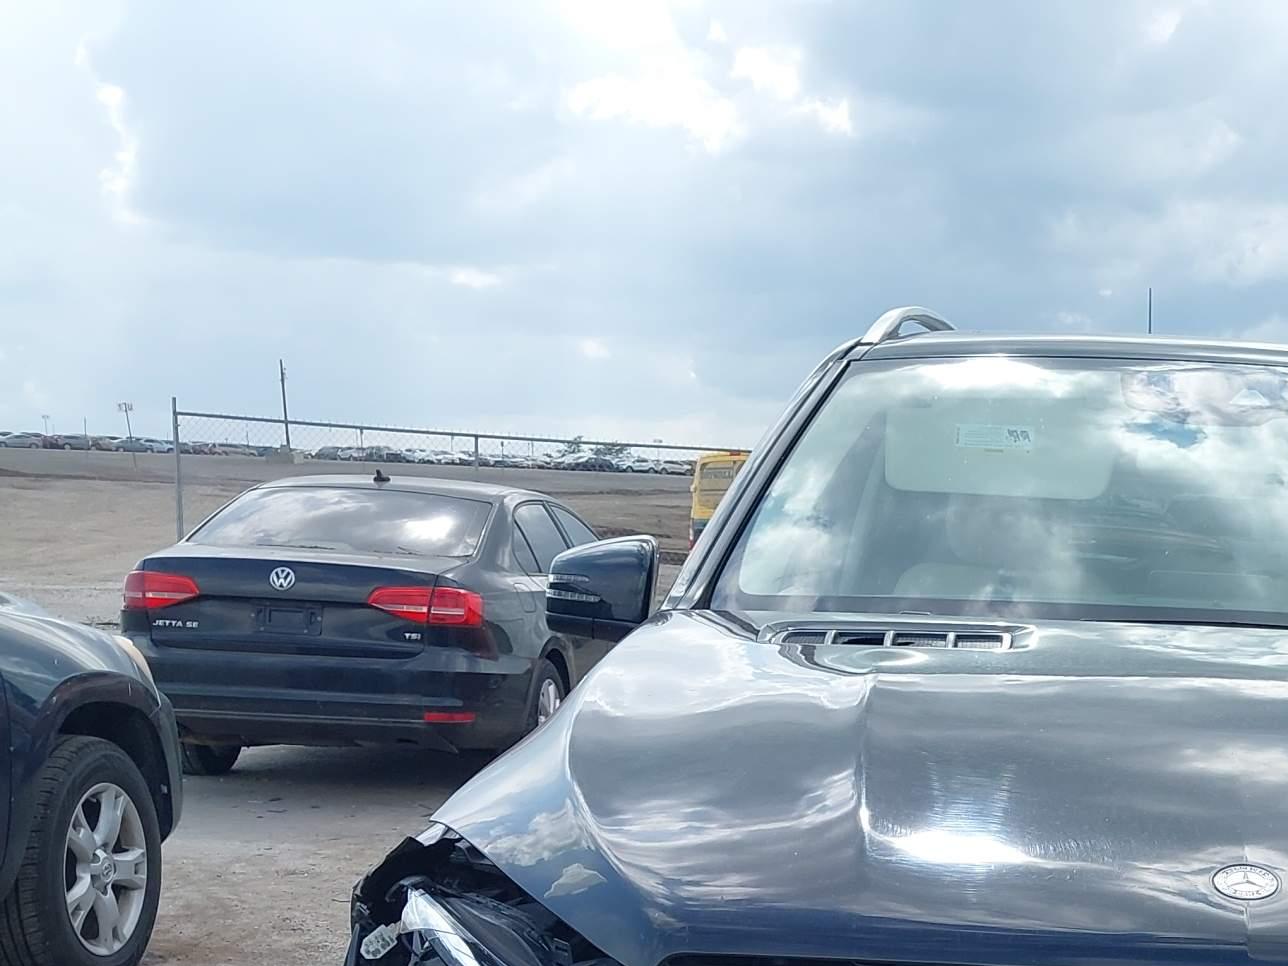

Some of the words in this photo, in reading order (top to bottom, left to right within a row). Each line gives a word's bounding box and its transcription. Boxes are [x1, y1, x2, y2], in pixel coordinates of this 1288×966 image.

[270, 567, 295, 590] VW
[152, 619, 183, 627] JETTA
[404, 632, 421, 640] TSI
